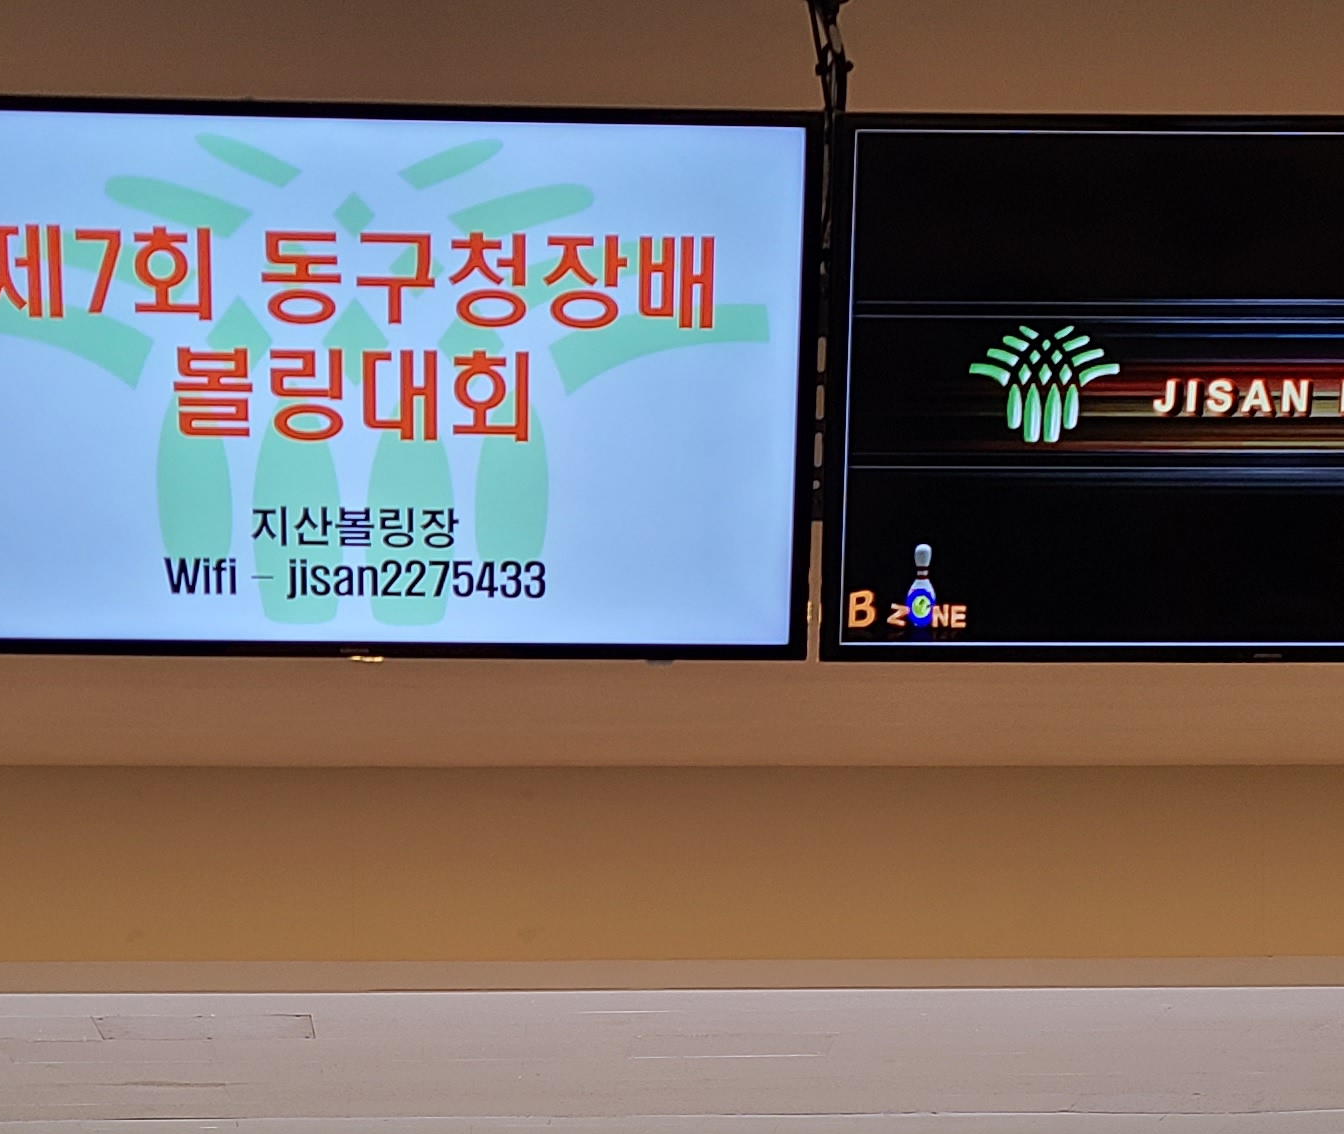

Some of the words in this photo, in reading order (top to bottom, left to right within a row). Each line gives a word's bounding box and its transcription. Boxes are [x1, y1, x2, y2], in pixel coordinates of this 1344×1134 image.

[260, 229, 717, 331] 동구청장배
[172, 345, 531, 443] 볼링대회
[1151, 378, 1312, 417] JISAN
[251, 505, 459, 549] 지산볼링장
[164, 556, 238, 597] Wifi
[287, 557, 547, 599] jisan2275433
